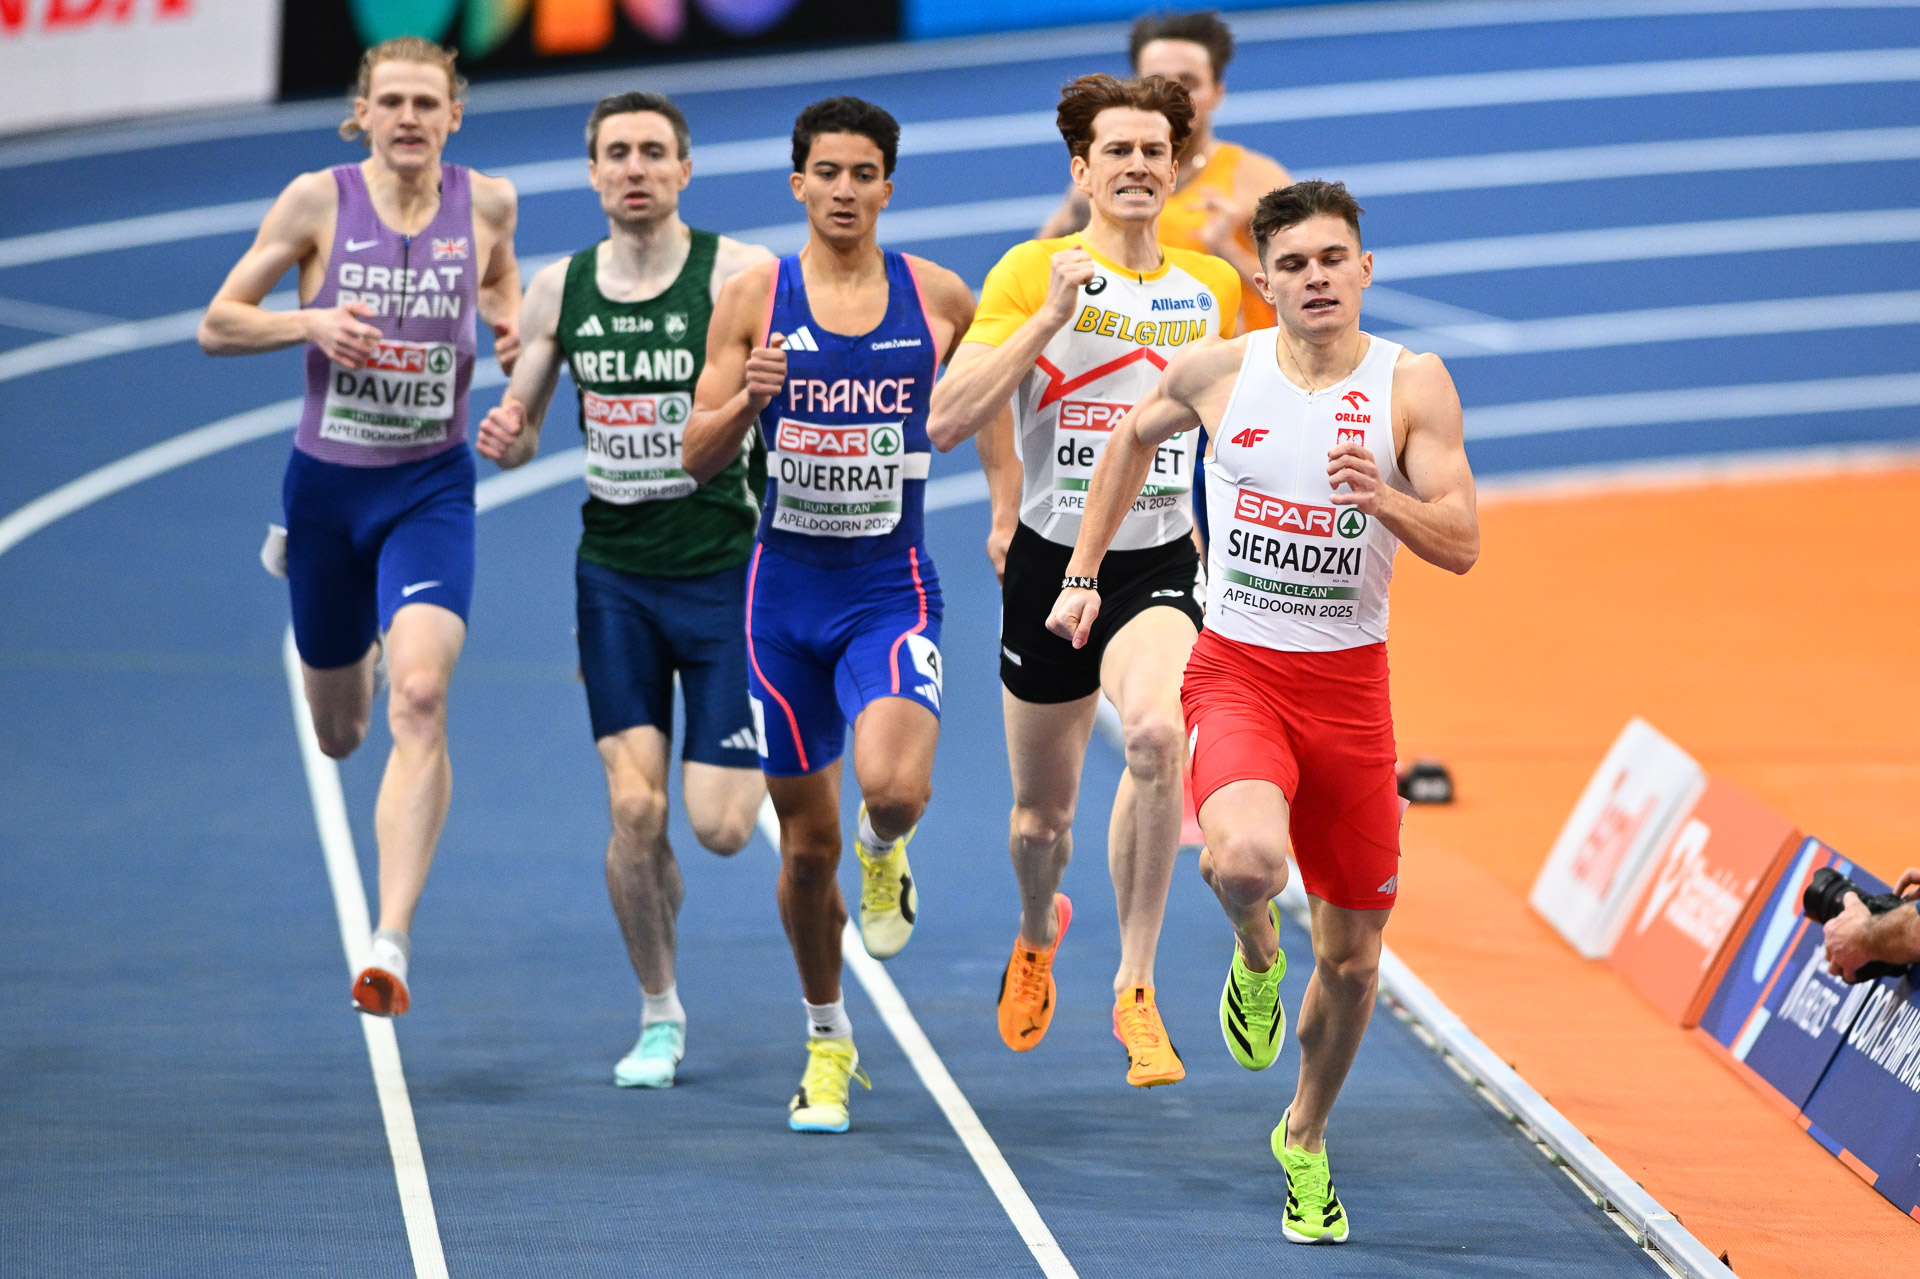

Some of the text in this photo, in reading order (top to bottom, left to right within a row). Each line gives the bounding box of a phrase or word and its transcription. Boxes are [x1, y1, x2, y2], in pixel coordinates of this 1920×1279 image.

[339, 263, 463, 293] GREAT
[337, 289, 461, 319] BRITAIN
[1151, 299, 1196, 312] Allianz
[611, 316, 654, 333] 123.ie
[1074, 305, 1207, 347] BELGIUM
[573, 348, 695, 383] IRELAND
[335, 371, 447, 408] DAVIES
[789, 377, 915, 415] FRANCE
[586, 401, 654, 424] SPAR
[1062, 404, 1127, 428] SPA
[1335, 412, 1371, 424] ORLEN
[588, 430, 682, 460] ENGLISH
[780, 427, 866, 454] SPAR
[1057, 437, 1095, 467] de
[1231, 427, 1270, 448] 4F
[780, 457, 899, 492] OUERRAT
[804, 502, 828, 514] RUN
[1149, 496, 1179, 510] 2025
[1237, 493, 1333, 534] SPAR
[779, 512, 896, 532] APELDOORN 2025
[1227, 528, 1362, 576] SIERADZKI
[1254, 578, 1283, 593] RUN
[1223, 588, 1354, 619] APELDOORN 2025
